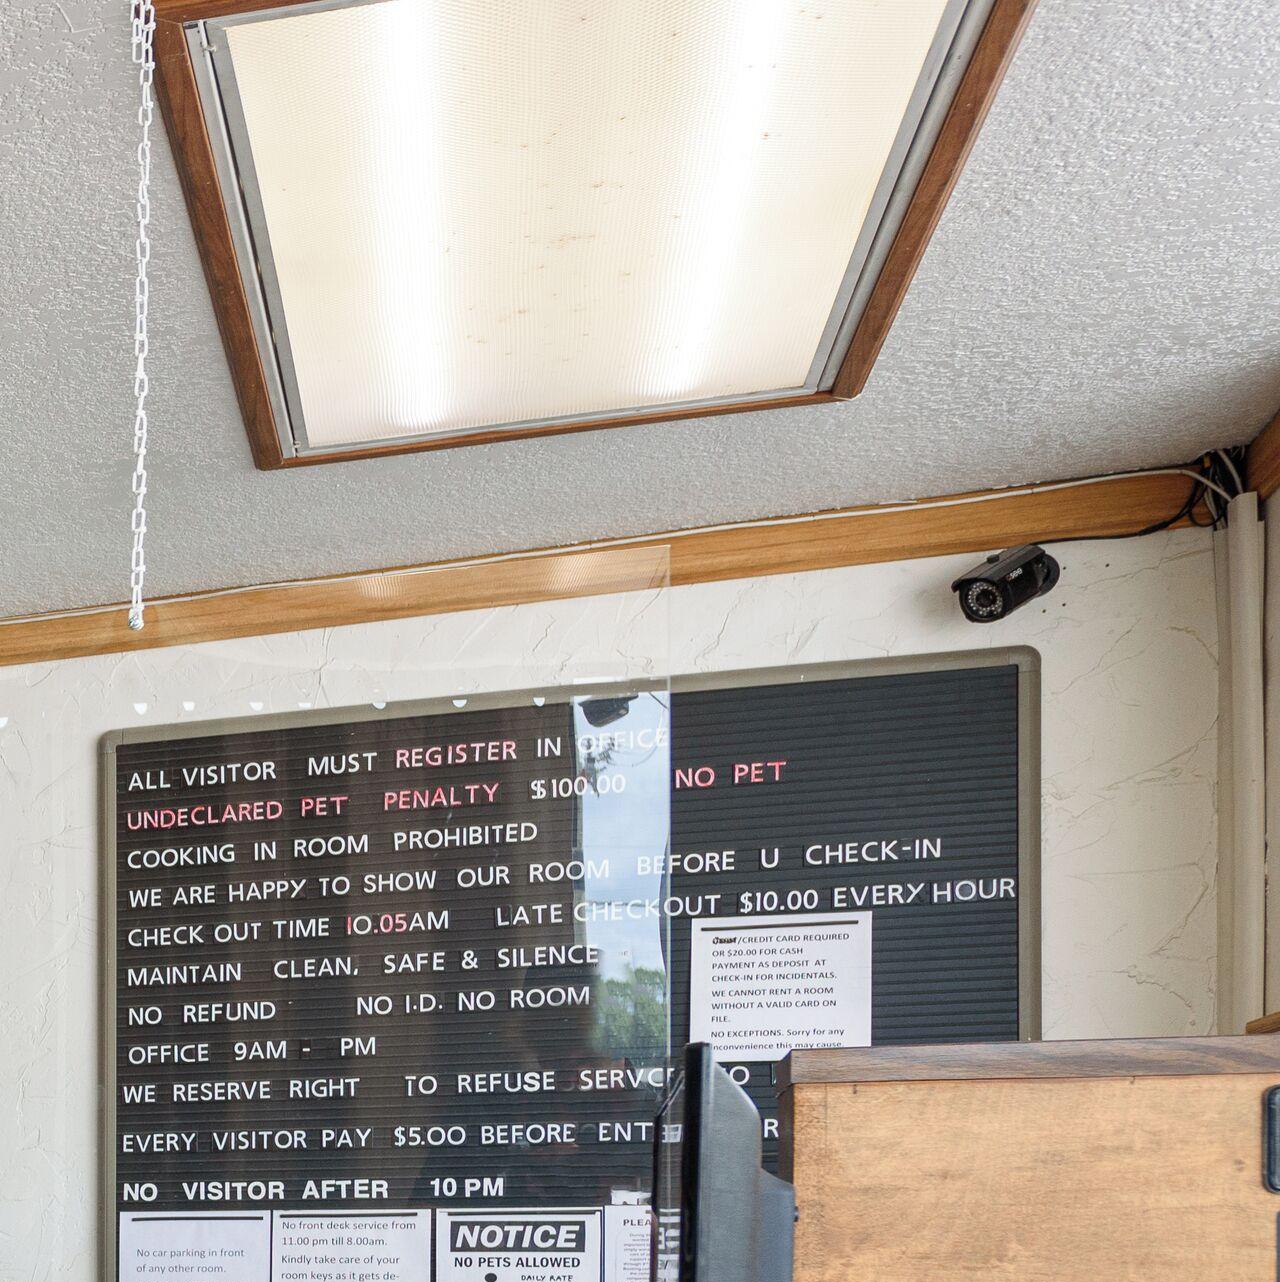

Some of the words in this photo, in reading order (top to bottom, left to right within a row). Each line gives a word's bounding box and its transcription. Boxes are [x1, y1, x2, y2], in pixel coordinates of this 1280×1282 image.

[129, 771, 170, 790] ALL
[183, 762, 276, 785] VISITOR
[309, 752, 377, 775] MUST
[397, 741, 517, 768] REGISTER
[538, 737, 561, 757] IN
[577, 728, 669, 752] OFFICE
[128, 801, 282, 829] UNDECLARED
[302, 797, 348, 816] PET
[385, 783, 499, 810] PENALTY
[530, 775, 626, 800] $100.00
[675, 766, 715, 788] NO
[735, 762, 786, 783] PET
[128, 844, 234, 868] COOKING
[255, 841, 276, 860] IN
[293, 834, 369, 858] ROOM
[394, 823, 537, 851] PROHIBITED
[130, 889, 161, 907] WE
[173, 885, 215, 905] ARE
[229, 879, 306, 902] HAPPY
[319, 877, 350, 896] TO
[364, 871, 436, 893] SHOW
[457, 866, 510, 887] OUR
[530, 859, 609, 884] ROOM
[636, 850, 735, 876] BEFORE
[761, 848, 778, 868] U
[806, 838, 940, 864] CHECK-IN
[128, 925, 204, 946] CHECK
[215, 923, 261, 942] OUT
[273, 918, 329, 938] TIME
[497, 904, 562, 926] LATE
[573, 894, 721, 923] CHECKOUT
[740, 890, 818, 914] $10.00
[833, 883, 925, 907] EVERY
[934, 878, 1015, 903] HOUR
[728, 989, 766, 997] CANNOT
[769, 988, 791, 996] RENT
[803, 987, 834, 995] ROOM
[124, 1183, 157, 1201] NO
[182, 1182, 284, 1200] VISITOR
[302, 1179, 388, 1199] AFTER
[431, 1178, 457, 1196] 10
[465, 1178, 503, 1197] PM
[282, 1221, 296, 1230] No
[298, 1221, 324, 1230] front
[326, 1221, 350, 1230] desk
[353, 1221, 389, 1230] service
[391, 1221, 416, 1230] from
[455, 1225, 580, 1248] NOTICE
[136, 1248, 150, 1257] No
[170, 1248, 206, 1259] parking
[208, 1248, 217, 1257] in
[220, 1248, 244, 1257] front
[282, 1237, 310, 1246] 11.00
[312, 1239, 328, 1247] pm
[331, 1237, 344, 1245] till
[346, 1237, 388, 1246] 8.00am.
[454, 1257, 473, 1268] NO
[478, 1257, 511, 1268] PETS
[516, 1257, 580, 1268] ALLOWED
